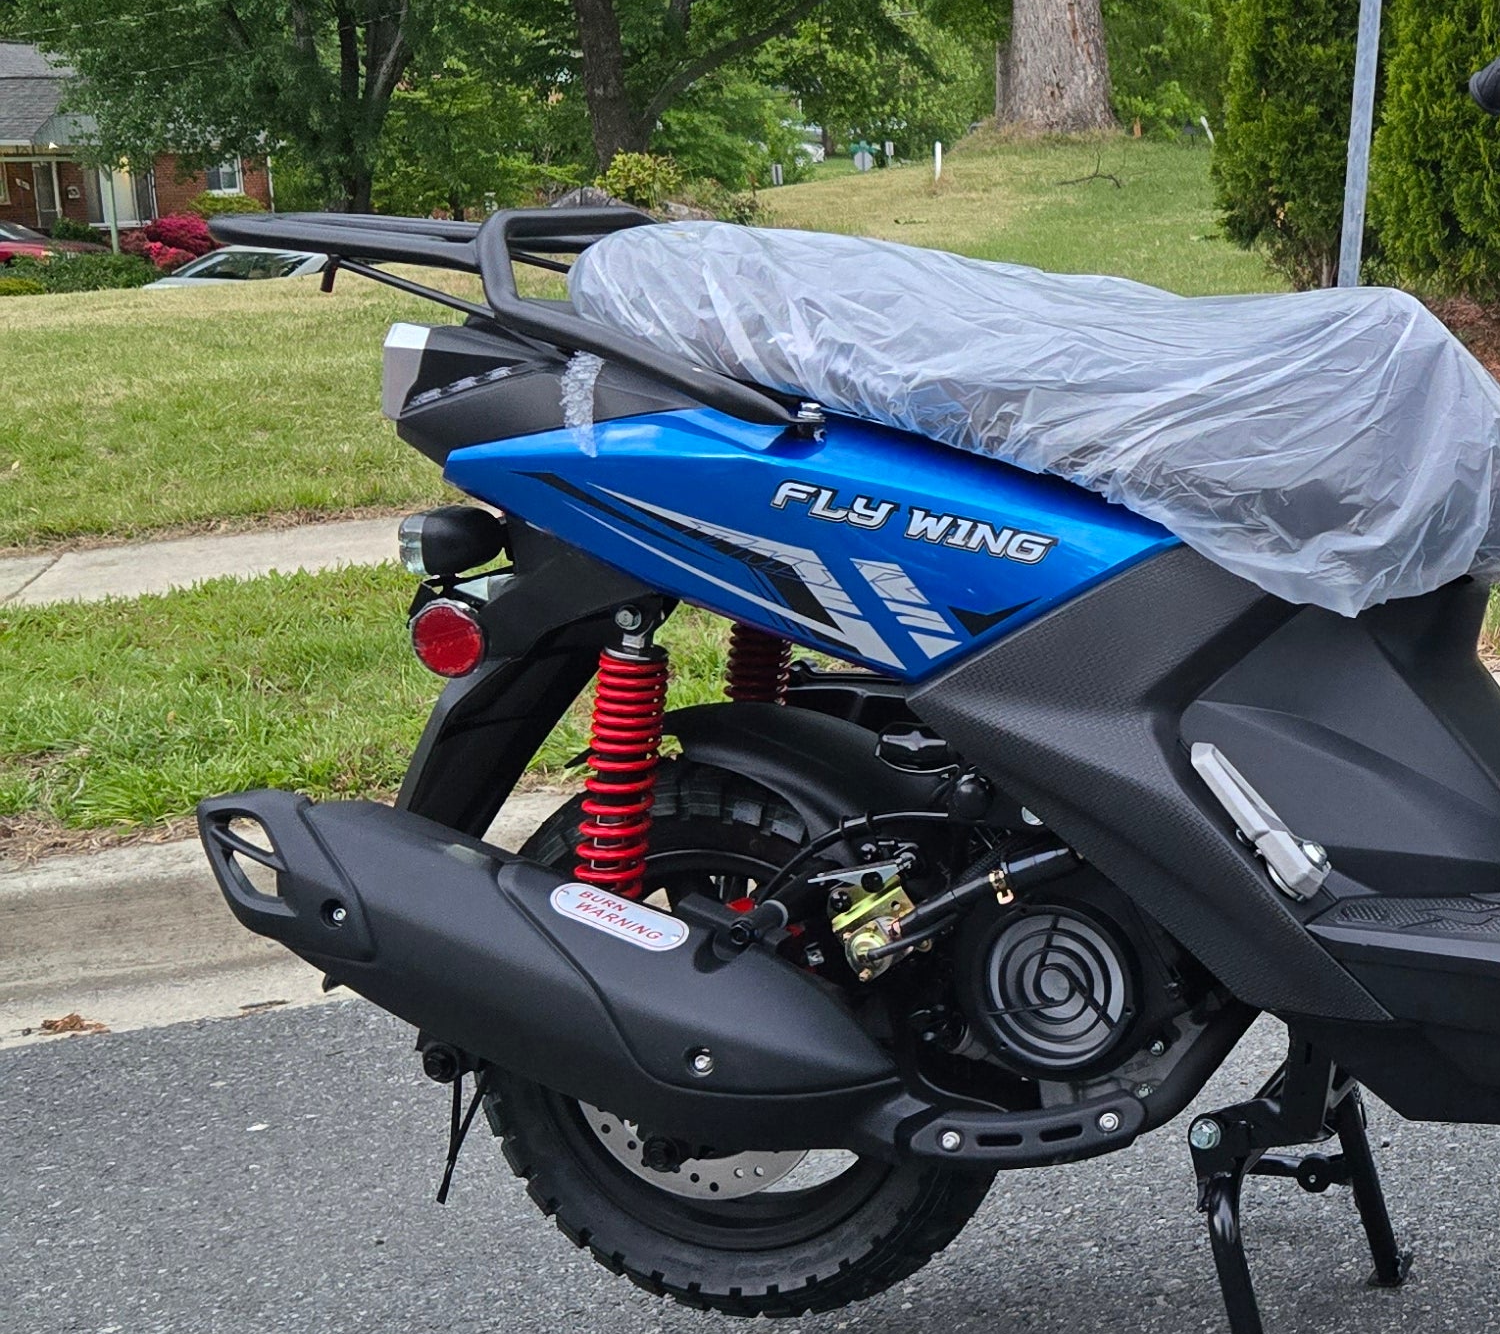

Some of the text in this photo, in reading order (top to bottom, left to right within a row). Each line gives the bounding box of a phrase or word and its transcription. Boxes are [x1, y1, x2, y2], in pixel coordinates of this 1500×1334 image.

[770, 480, 1058, 564] FLY WING
[579, 890, 628, 912] BURN
[575, 902, 663, 940] WARNING
